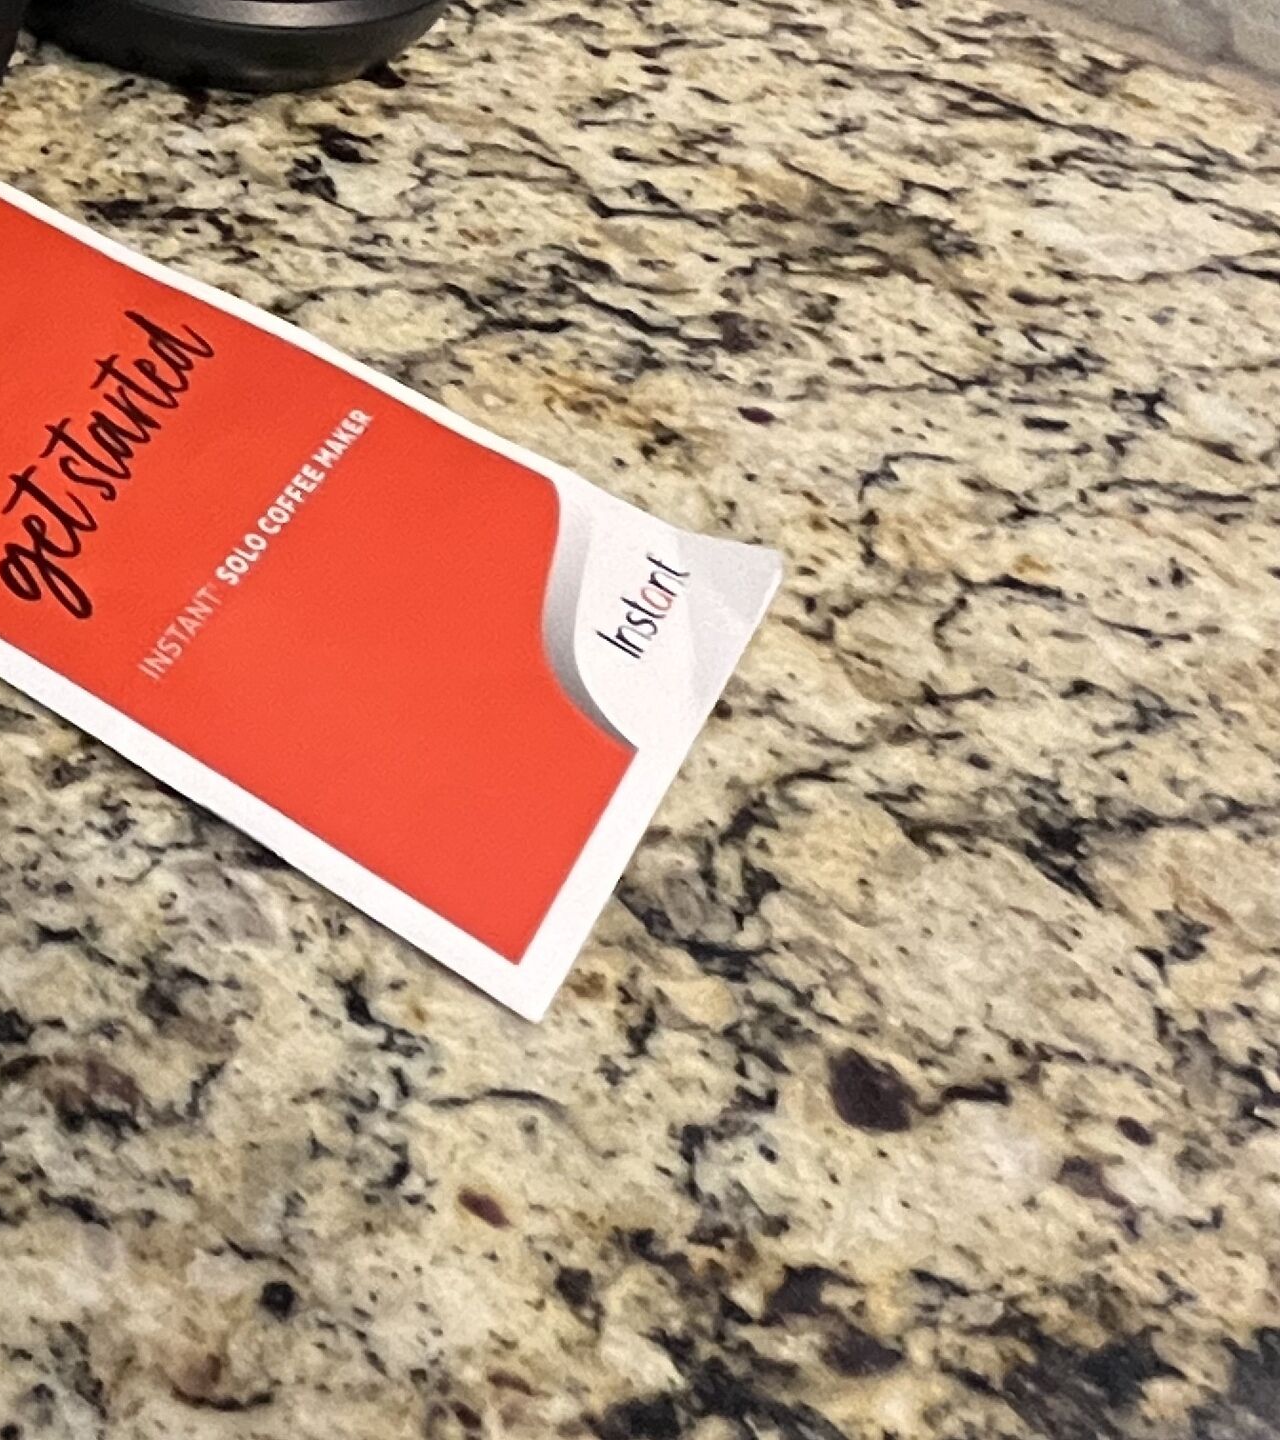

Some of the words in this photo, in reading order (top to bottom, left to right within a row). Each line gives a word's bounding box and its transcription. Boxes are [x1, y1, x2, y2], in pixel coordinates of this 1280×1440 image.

[38, 309, 216, 502] started
[136, 588, 223, 682] INSTANT
[214, 532, 269, 587] SOLO
[256, 463, 327, 536] COFFEE
[311, 407, 374, 470] MAKER
[594, 551, 691, 660] Instant
